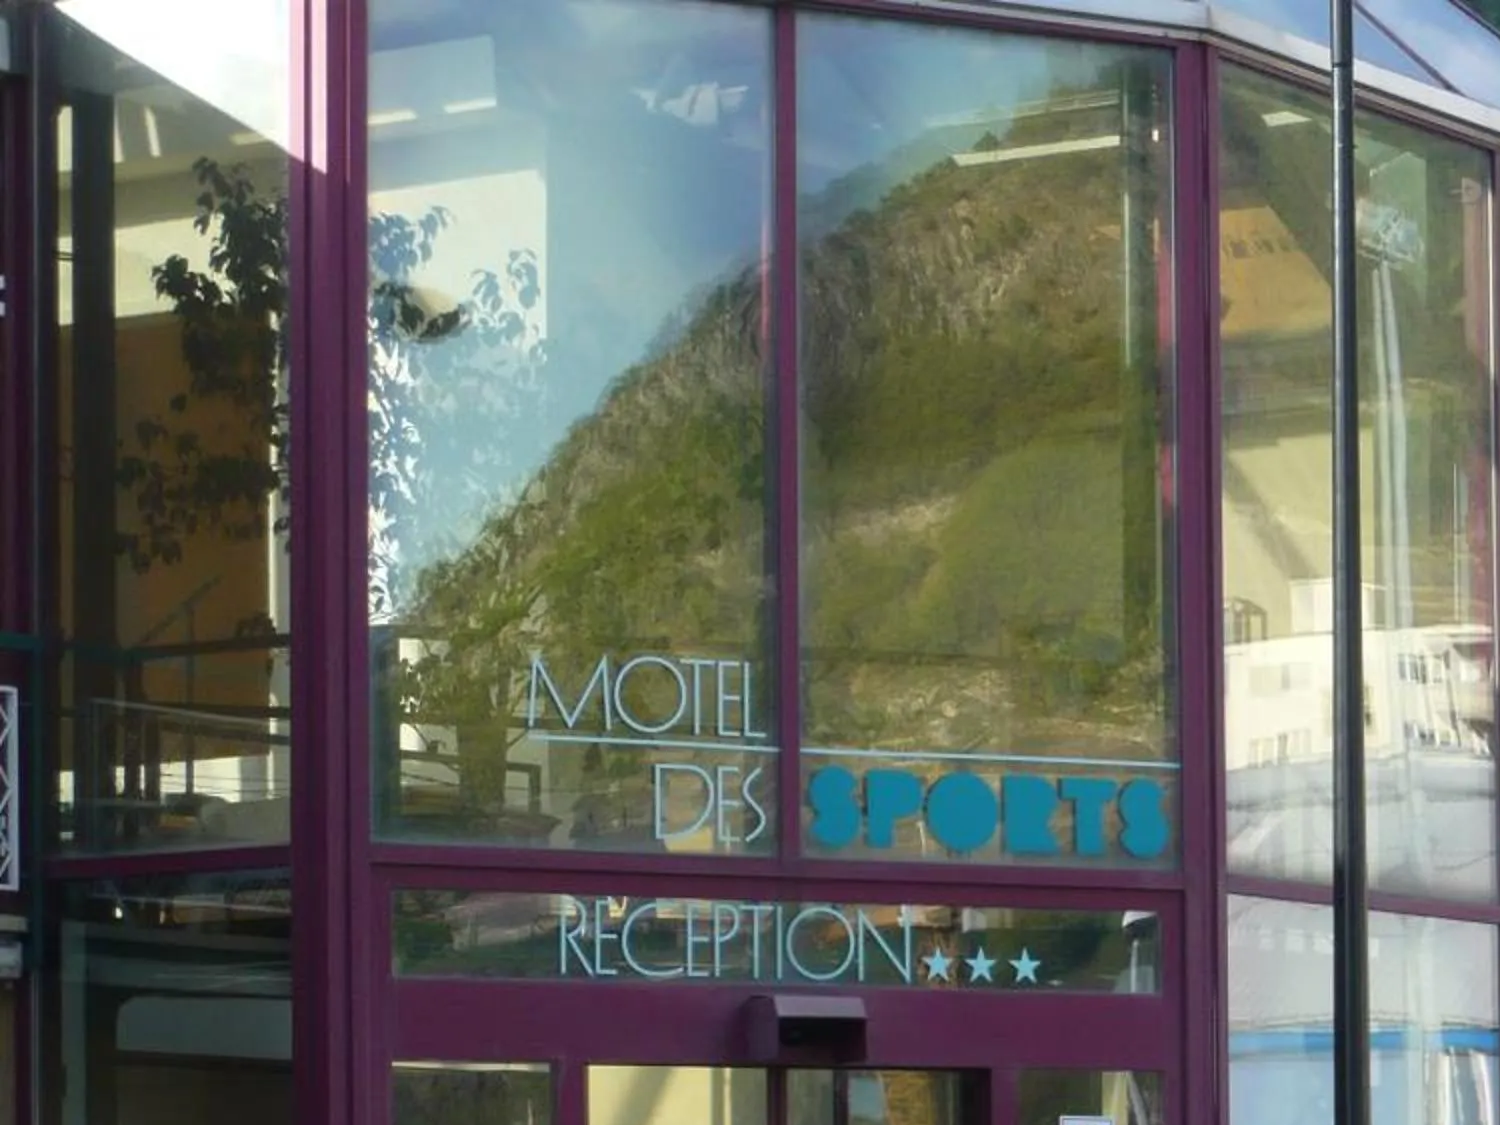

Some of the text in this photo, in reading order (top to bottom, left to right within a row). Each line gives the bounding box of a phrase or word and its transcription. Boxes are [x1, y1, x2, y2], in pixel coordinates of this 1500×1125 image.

[527, 654, 768, 738] MOTEL
[654, 762, 1172, 861] DES SPORTS
[556, 895, 914, 984] RECEPTION
